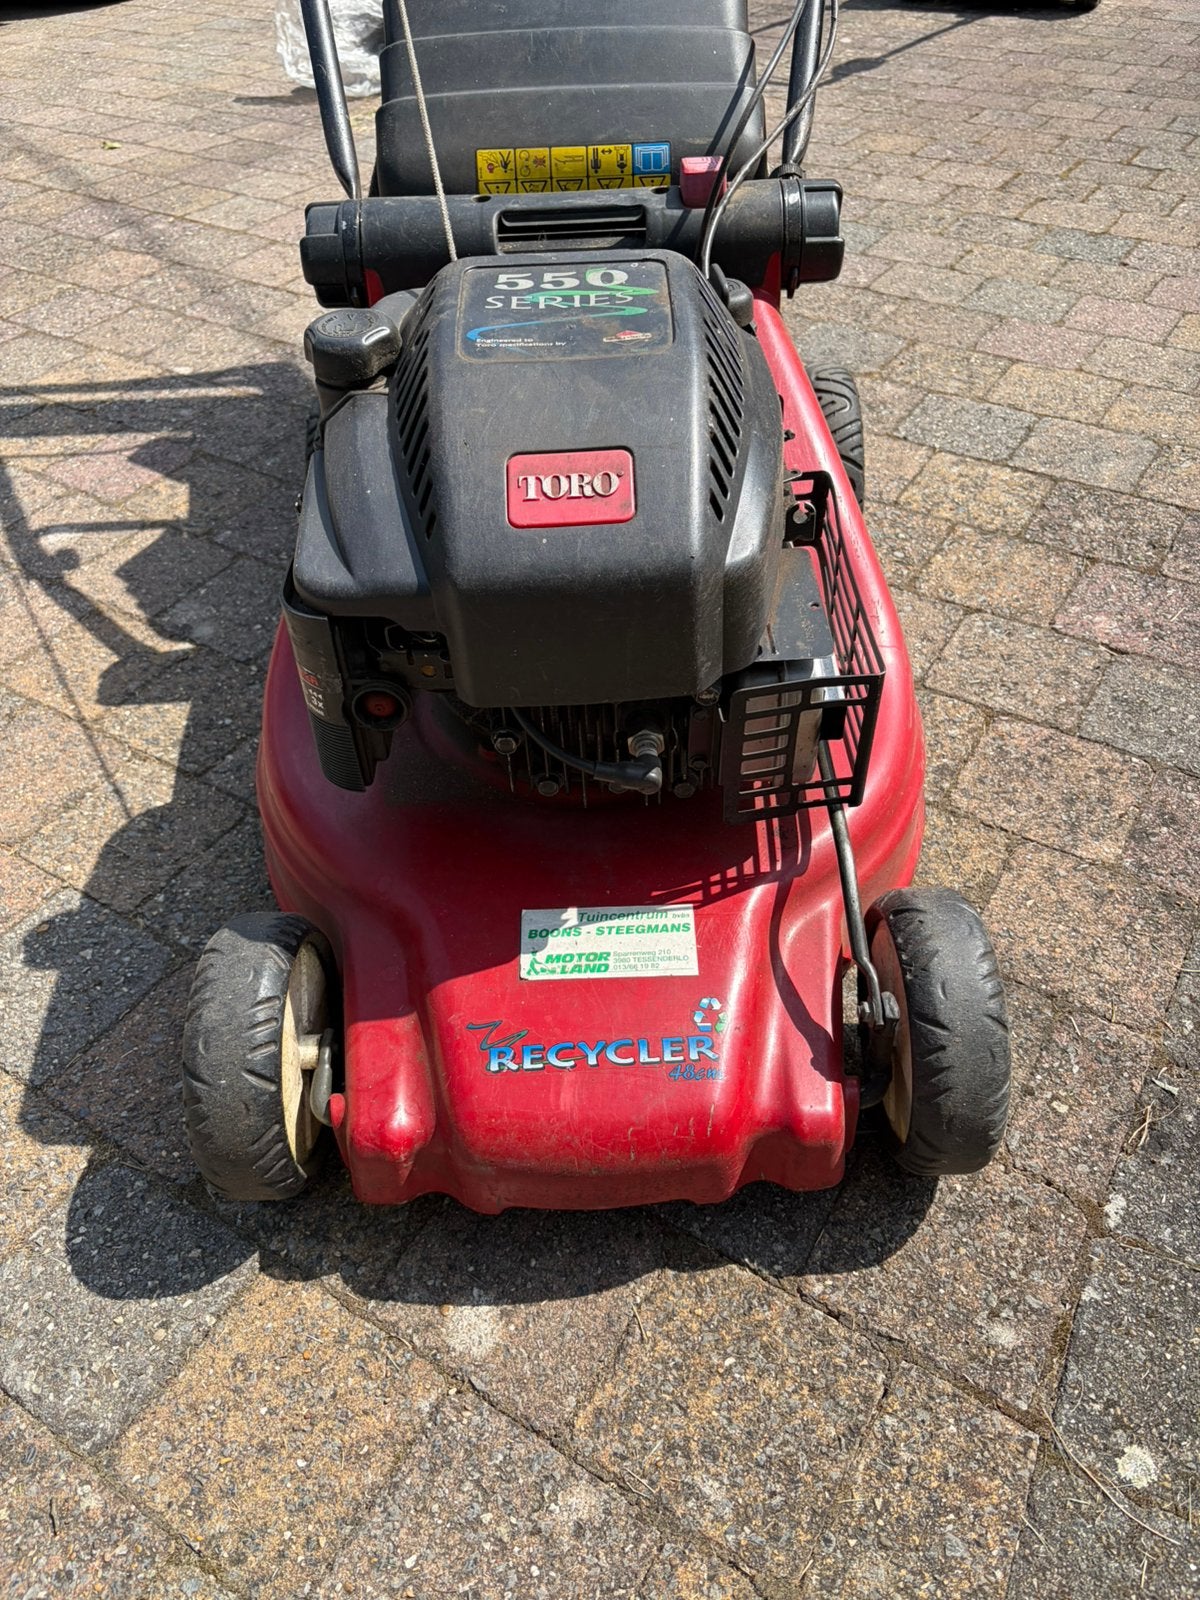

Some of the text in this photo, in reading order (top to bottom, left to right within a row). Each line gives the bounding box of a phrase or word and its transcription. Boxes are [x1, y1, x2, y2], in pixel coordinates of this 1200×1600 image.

[494, 269, 629, 290] 550
[484, 291, 634, 310] SERIES
[517, 470, 620, 501] TORO
[578, 911, 668, 922] Tuincentrum
[528, 927, 582, 939] BOONS
[595, 923, 691, 935] STEEGMANS
[545, 952, 611, 964] MOTOR
[632, 955, 689, 963] TESSENDERLO
[560, 963, 610, 975] LAND
[487, 1036, 720, 1073] RECYCLER
[668, 1064, 724, 1081] 48cm
